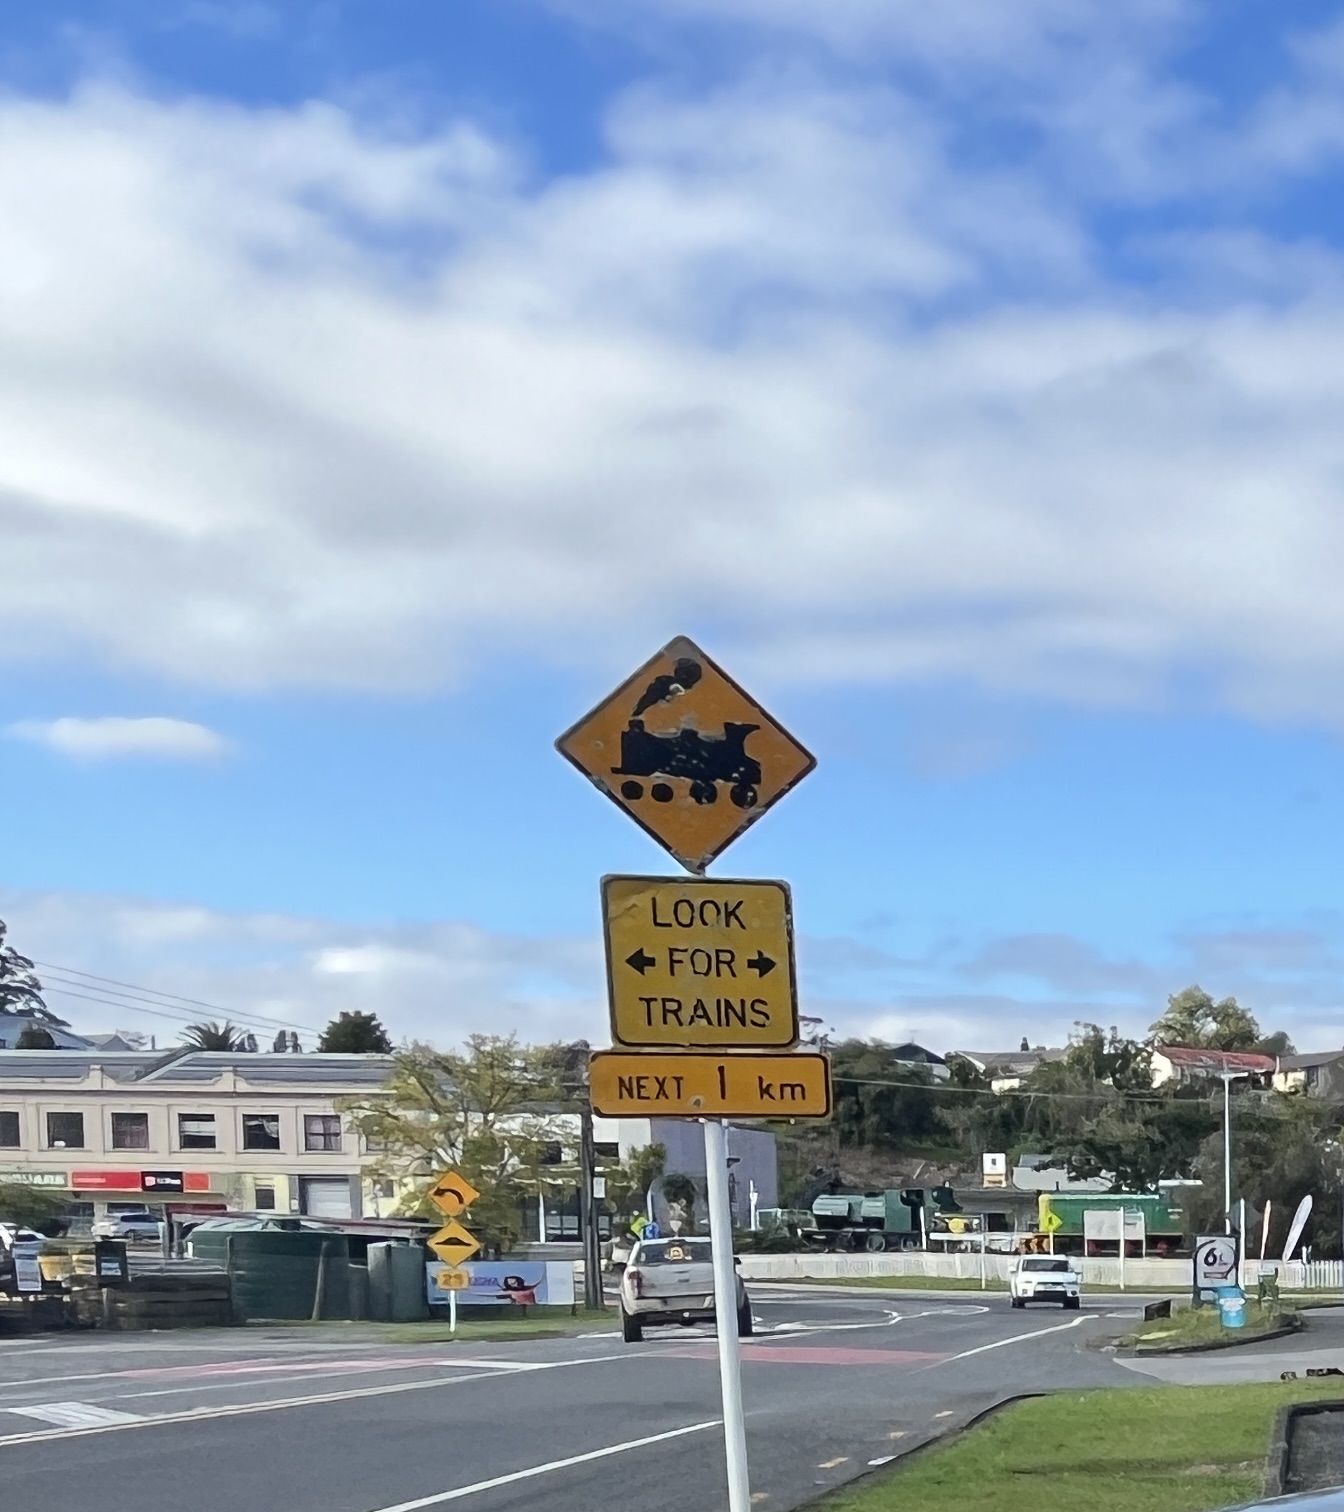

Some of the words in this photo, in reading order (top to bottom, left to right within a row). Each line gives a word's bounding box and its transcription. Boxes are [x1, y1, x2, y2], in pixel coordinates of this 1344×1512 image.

[652, 896, 746, 931] LOOK
[668, 947, 737, 978] FOR
[638, 996, 771, 1028] TRAINS
[617, 1075, 684, 1101] NEXT
[717, 1065, 726, 1100] 1
[758, 1075, 806, 1102] km
